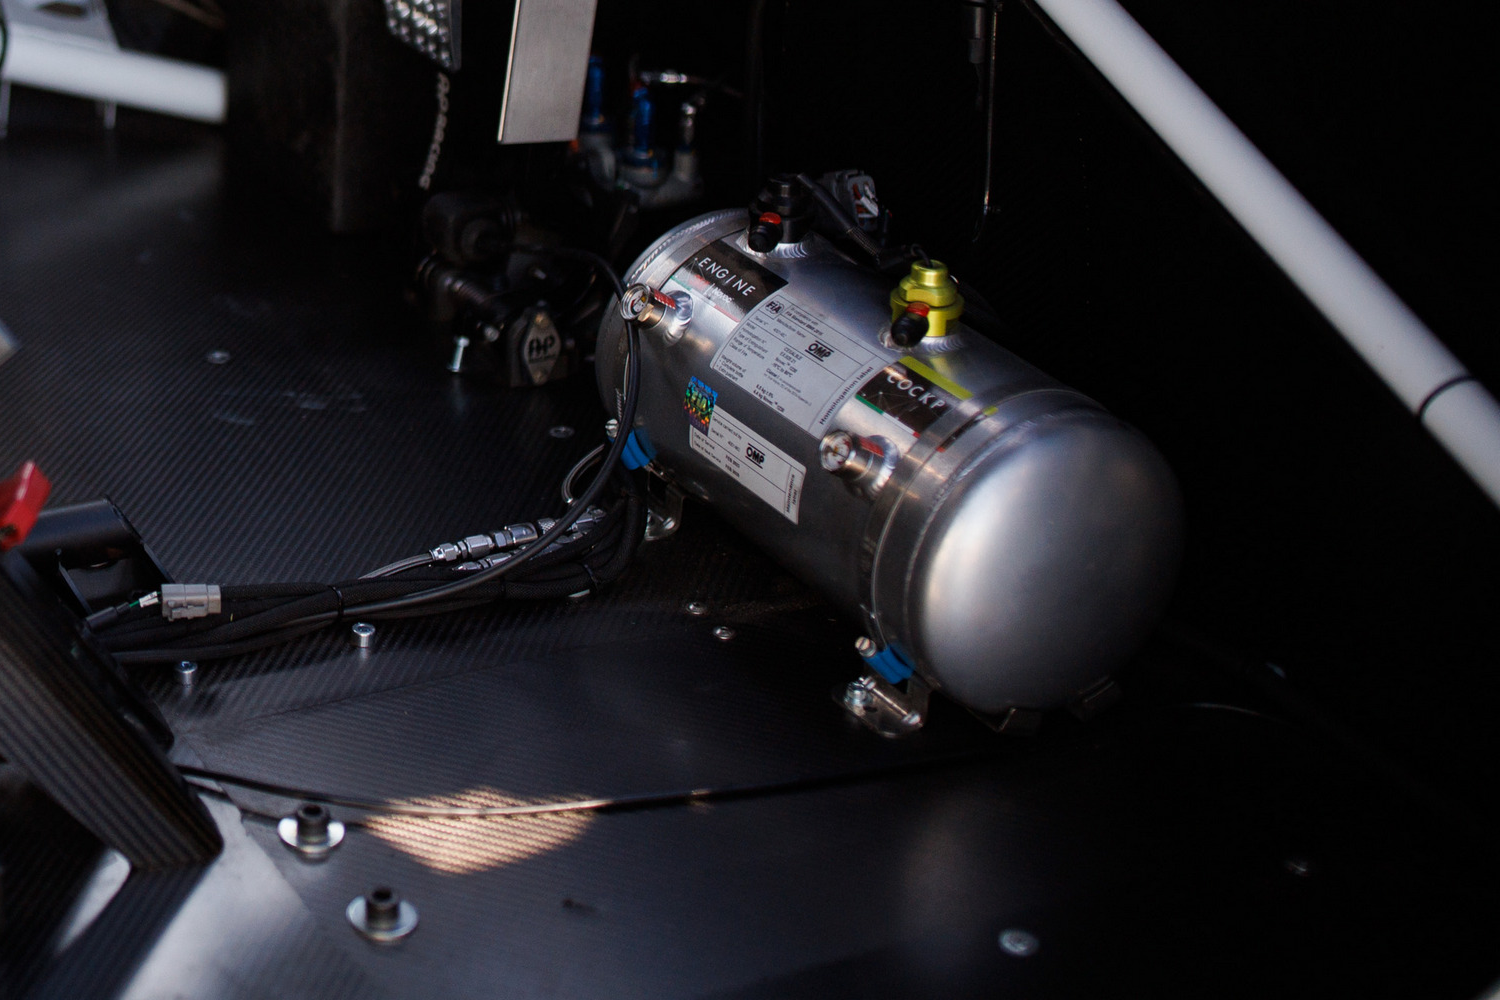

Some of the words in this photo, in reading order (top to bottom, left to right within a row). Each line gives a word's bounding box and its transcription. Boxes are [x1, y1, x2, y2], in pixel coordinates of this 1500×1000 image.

[698, 257, 756, 296] ENGINE
[765, 301, 783, 314] FIA
[790, 314, 807, 326] Standard
[808, 342, 831, 360] OMP
[819, 379, 858, 426] Homologation
[856, 366, 874, 383] label
[886, 373, 946, 410] COCKP
[746, 447, 765, 464] OMP
